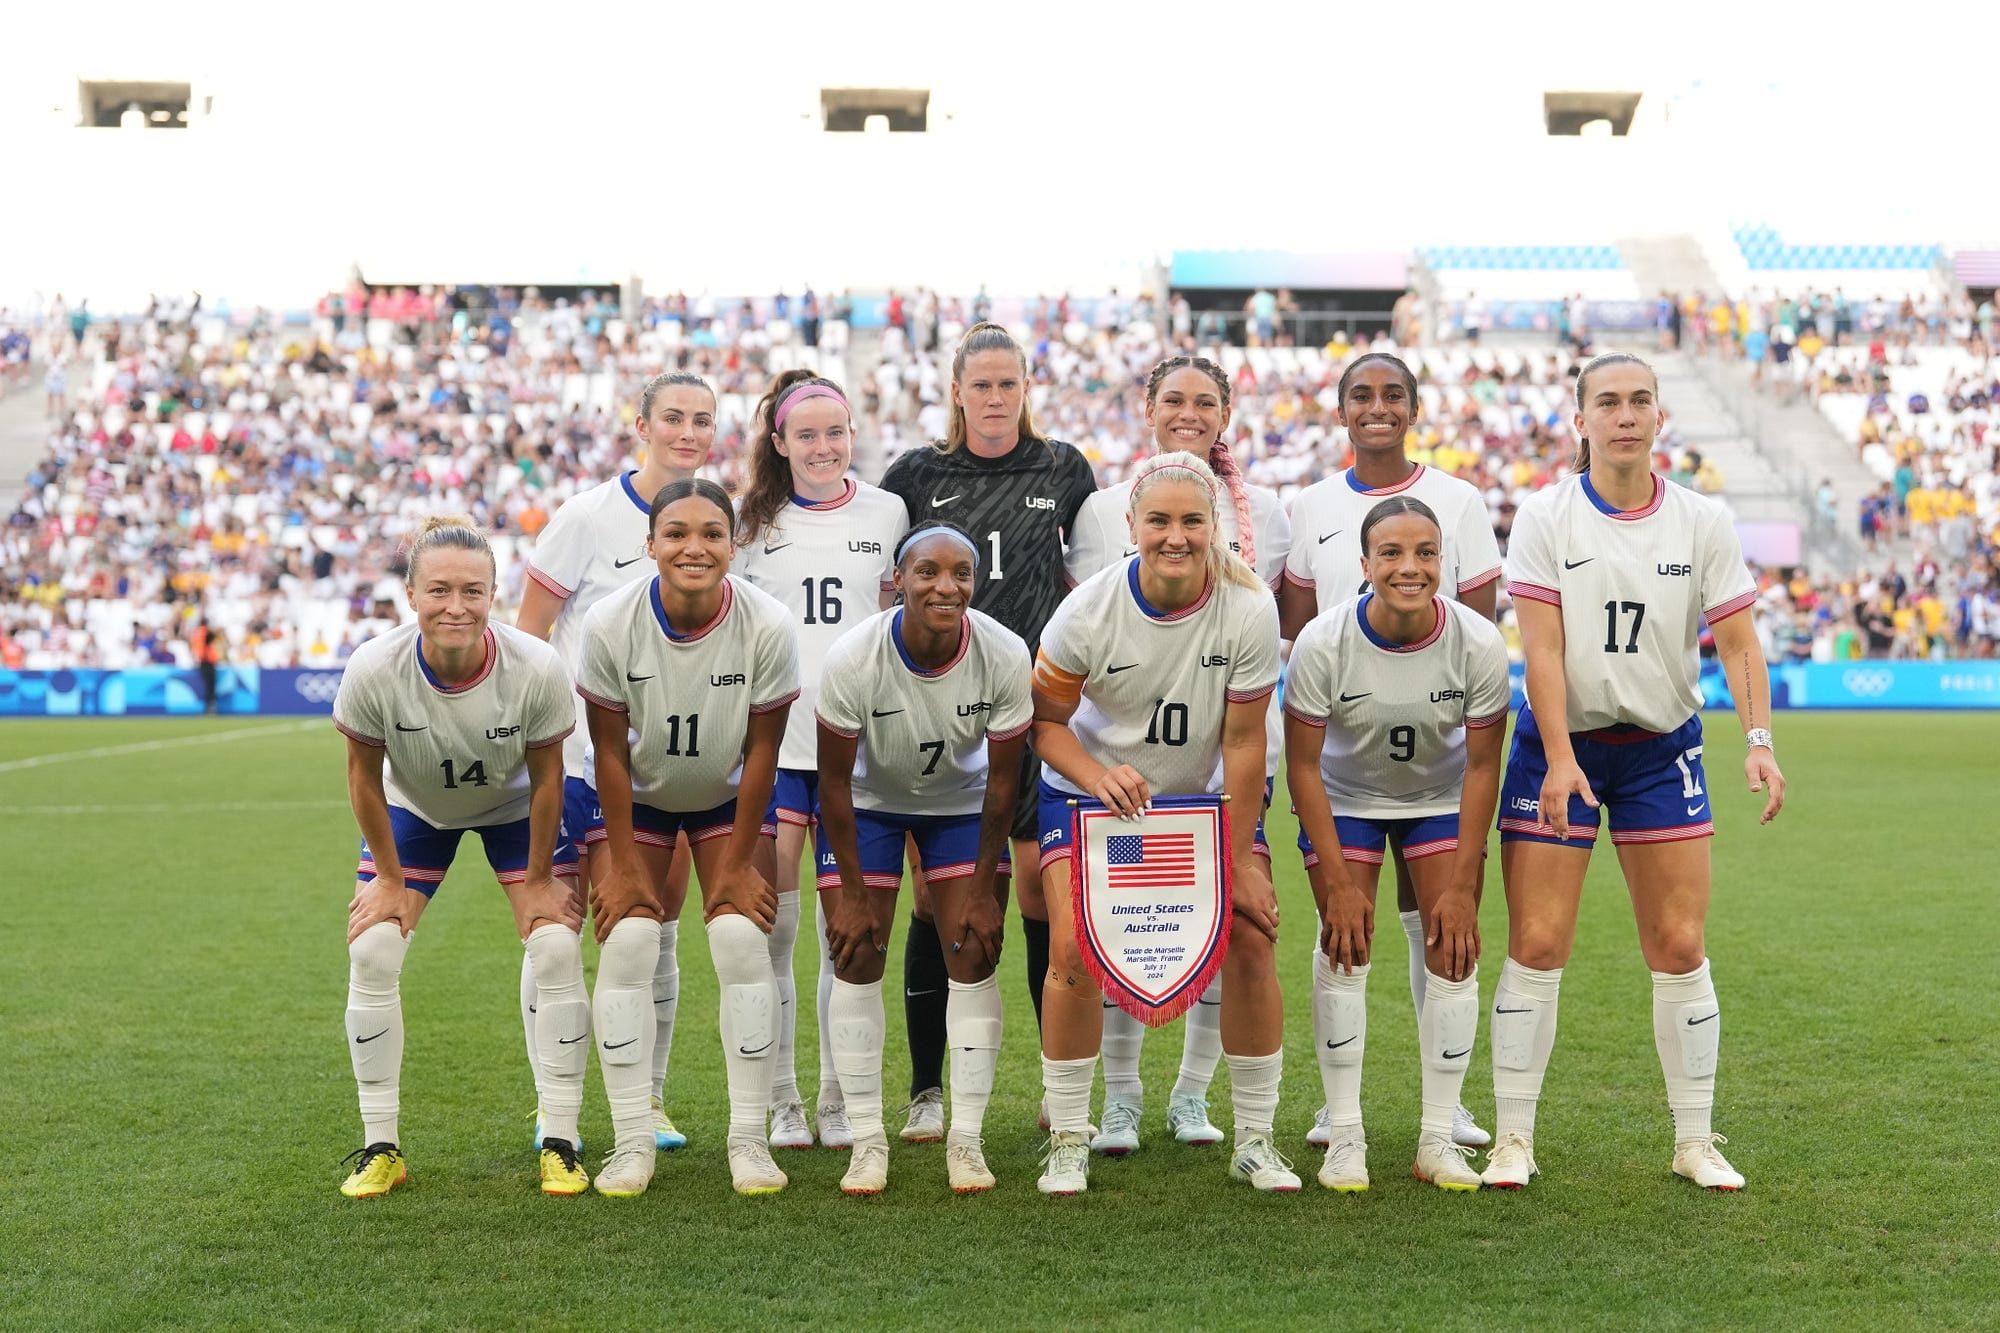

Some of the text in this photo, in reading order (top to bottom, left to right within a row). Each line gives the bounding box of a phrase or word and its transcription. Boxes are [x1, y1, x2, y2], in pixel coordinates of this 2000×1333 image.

[1025, 496, 1056, 511] USA
[848, 541, 881, 555] USA
[987, 530, 1003, 580] 1
[1657, 563, 1692, 577] USA
[801, 576, 843, 625] 16
[1604, 600, 1645, 654] 17
[710, 673, 746, 687] USA
[1430, 689, 1465, 704] USA
[1145, 698, 1189, 746] 10
[666, 713, 700, 757] 11
[1389, 725, 1416, 762] 9
[919, 739, 945, 776] 7
[440, 760, 488, 789] 14
[1511, 796, 1540, 813] USA
[1040, 828, 1063, 849] USA
[822, 853, 837, 866] US
[1111, 904, 1195, 915] United States
[1124, 923, 1180, 933] Australia
[1154, 946, 1186, 954] Marseille
